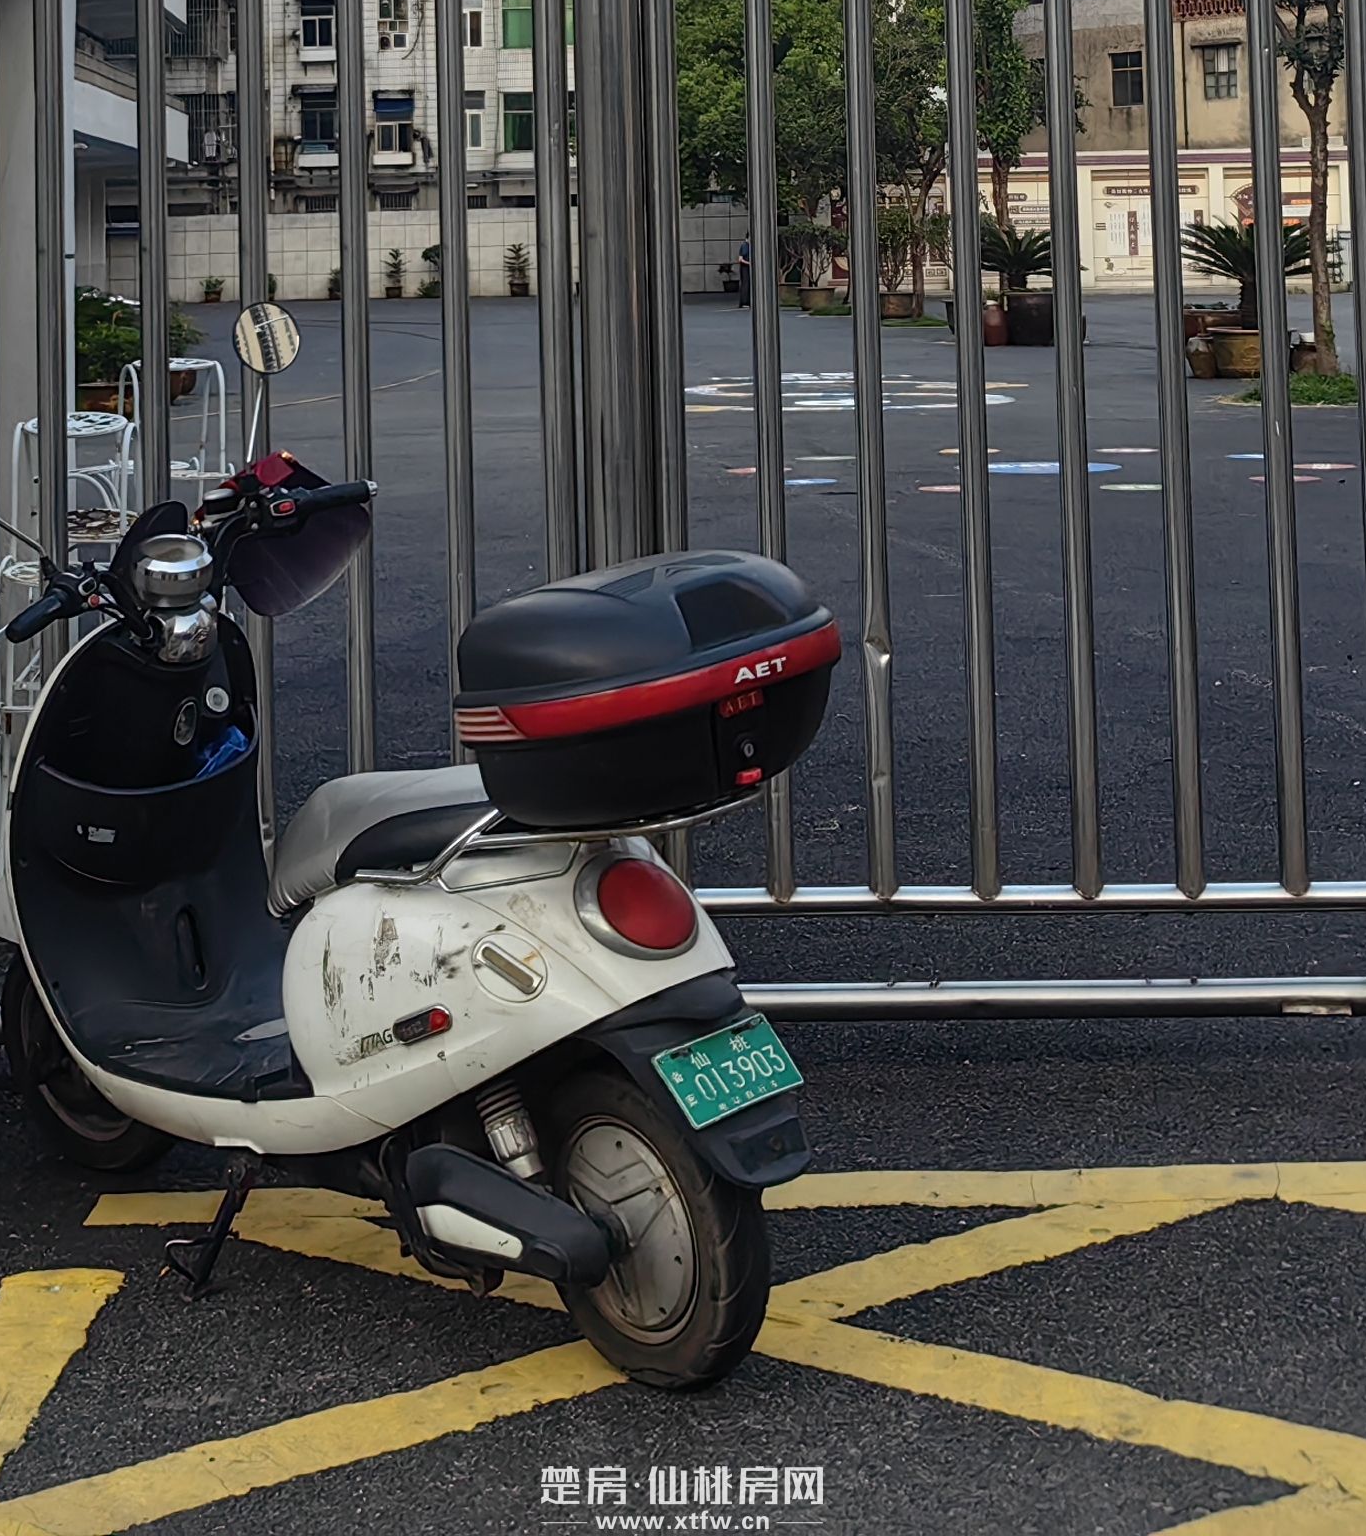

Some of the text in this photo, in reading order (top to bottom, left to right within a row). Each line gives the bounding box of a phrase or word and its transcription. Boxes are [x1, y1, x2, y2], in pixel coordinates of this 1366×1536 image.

[735, 657, 787, 684] AET
[725, 690, 758, 713] AET
[691, 1035, 751, 1070] 仙桃
[695, 1044, 786, 1101] 013903
